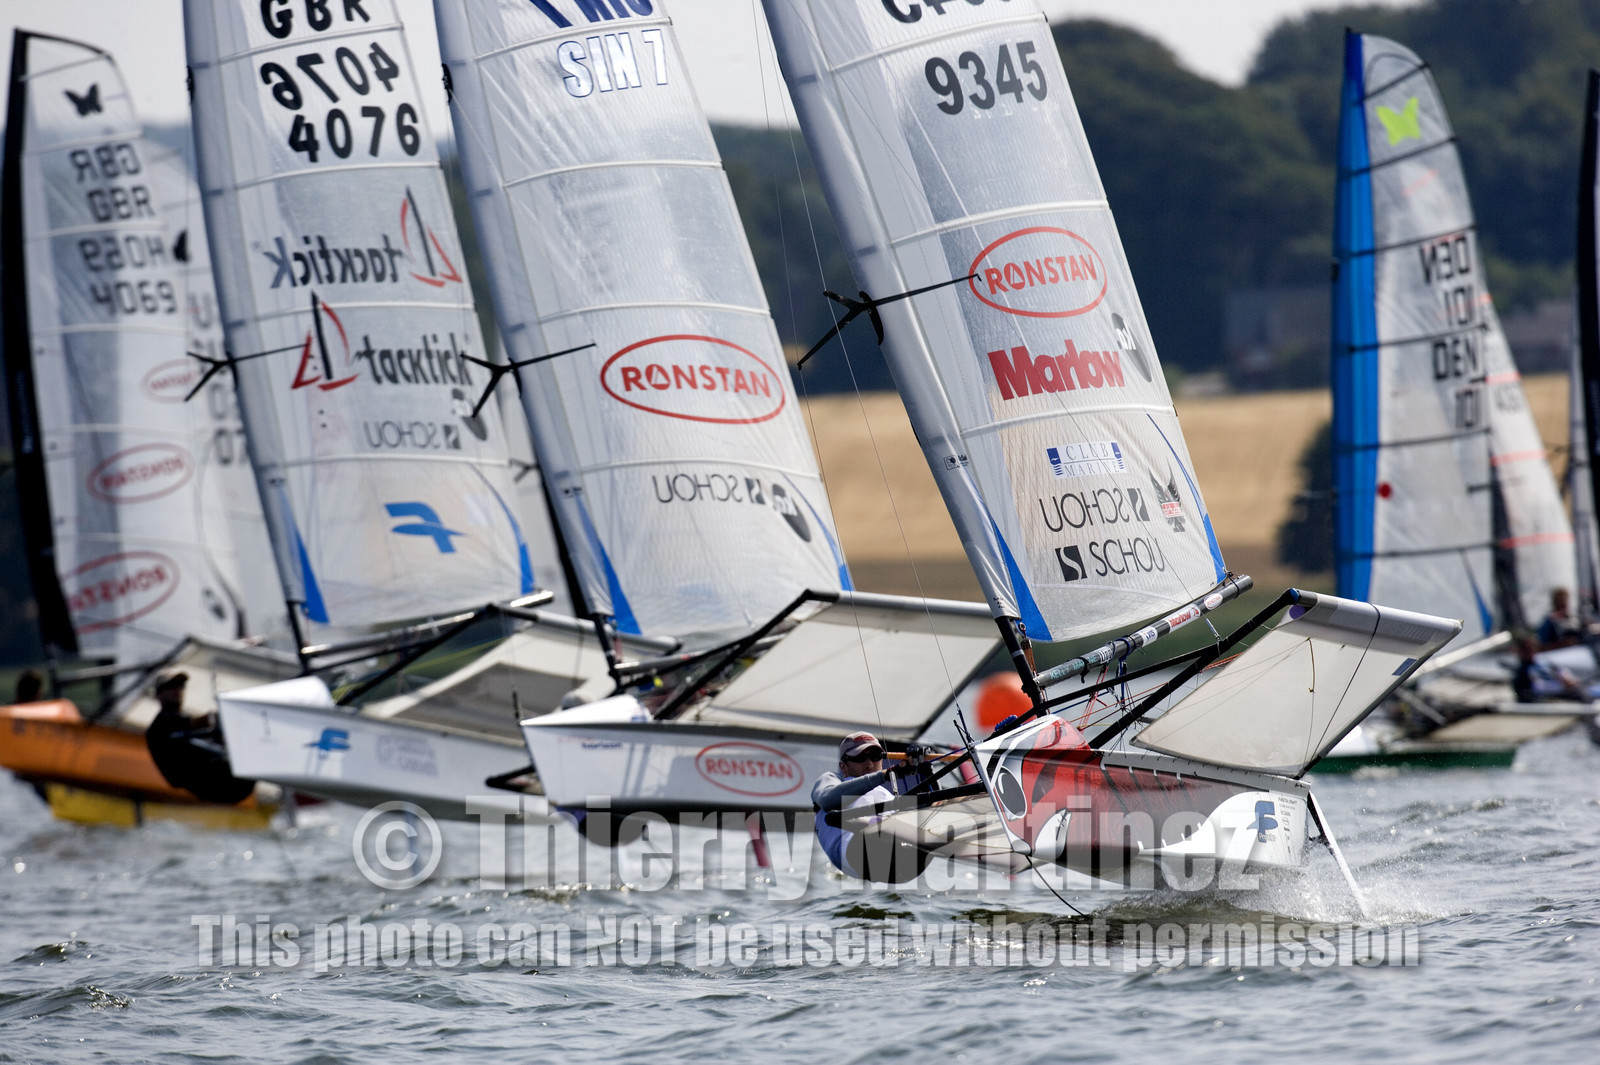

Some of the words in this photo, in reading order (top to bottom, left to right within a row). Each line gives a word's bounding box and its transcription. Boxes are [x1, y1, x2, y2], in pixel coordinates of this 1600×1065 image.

[557, 32, 642, 98] SIN
[641, 28, 668, 86] 7
[925, 41, 1048, 115] 9345
[288, 103, 420, 163] 4076
[87, 185, 155, 222] GBR
[984, 254, 1098, 295] RONSTAN
[90, 281, 178, 318] 4069
[352, 333, 474, 386] tacktick
[988, 339, 1126, 400] Marlow
[1432, 332, 1480, 381] DEN
[620, 364, 771, 398] RONSTAN
[1064, 460, 1120, 477] MARINE
[1066, 443, 1109, 460] CLUB
[1089, 536, 1165, 577] SCHOU
[705, 758, 793, 779] RONSTAN
